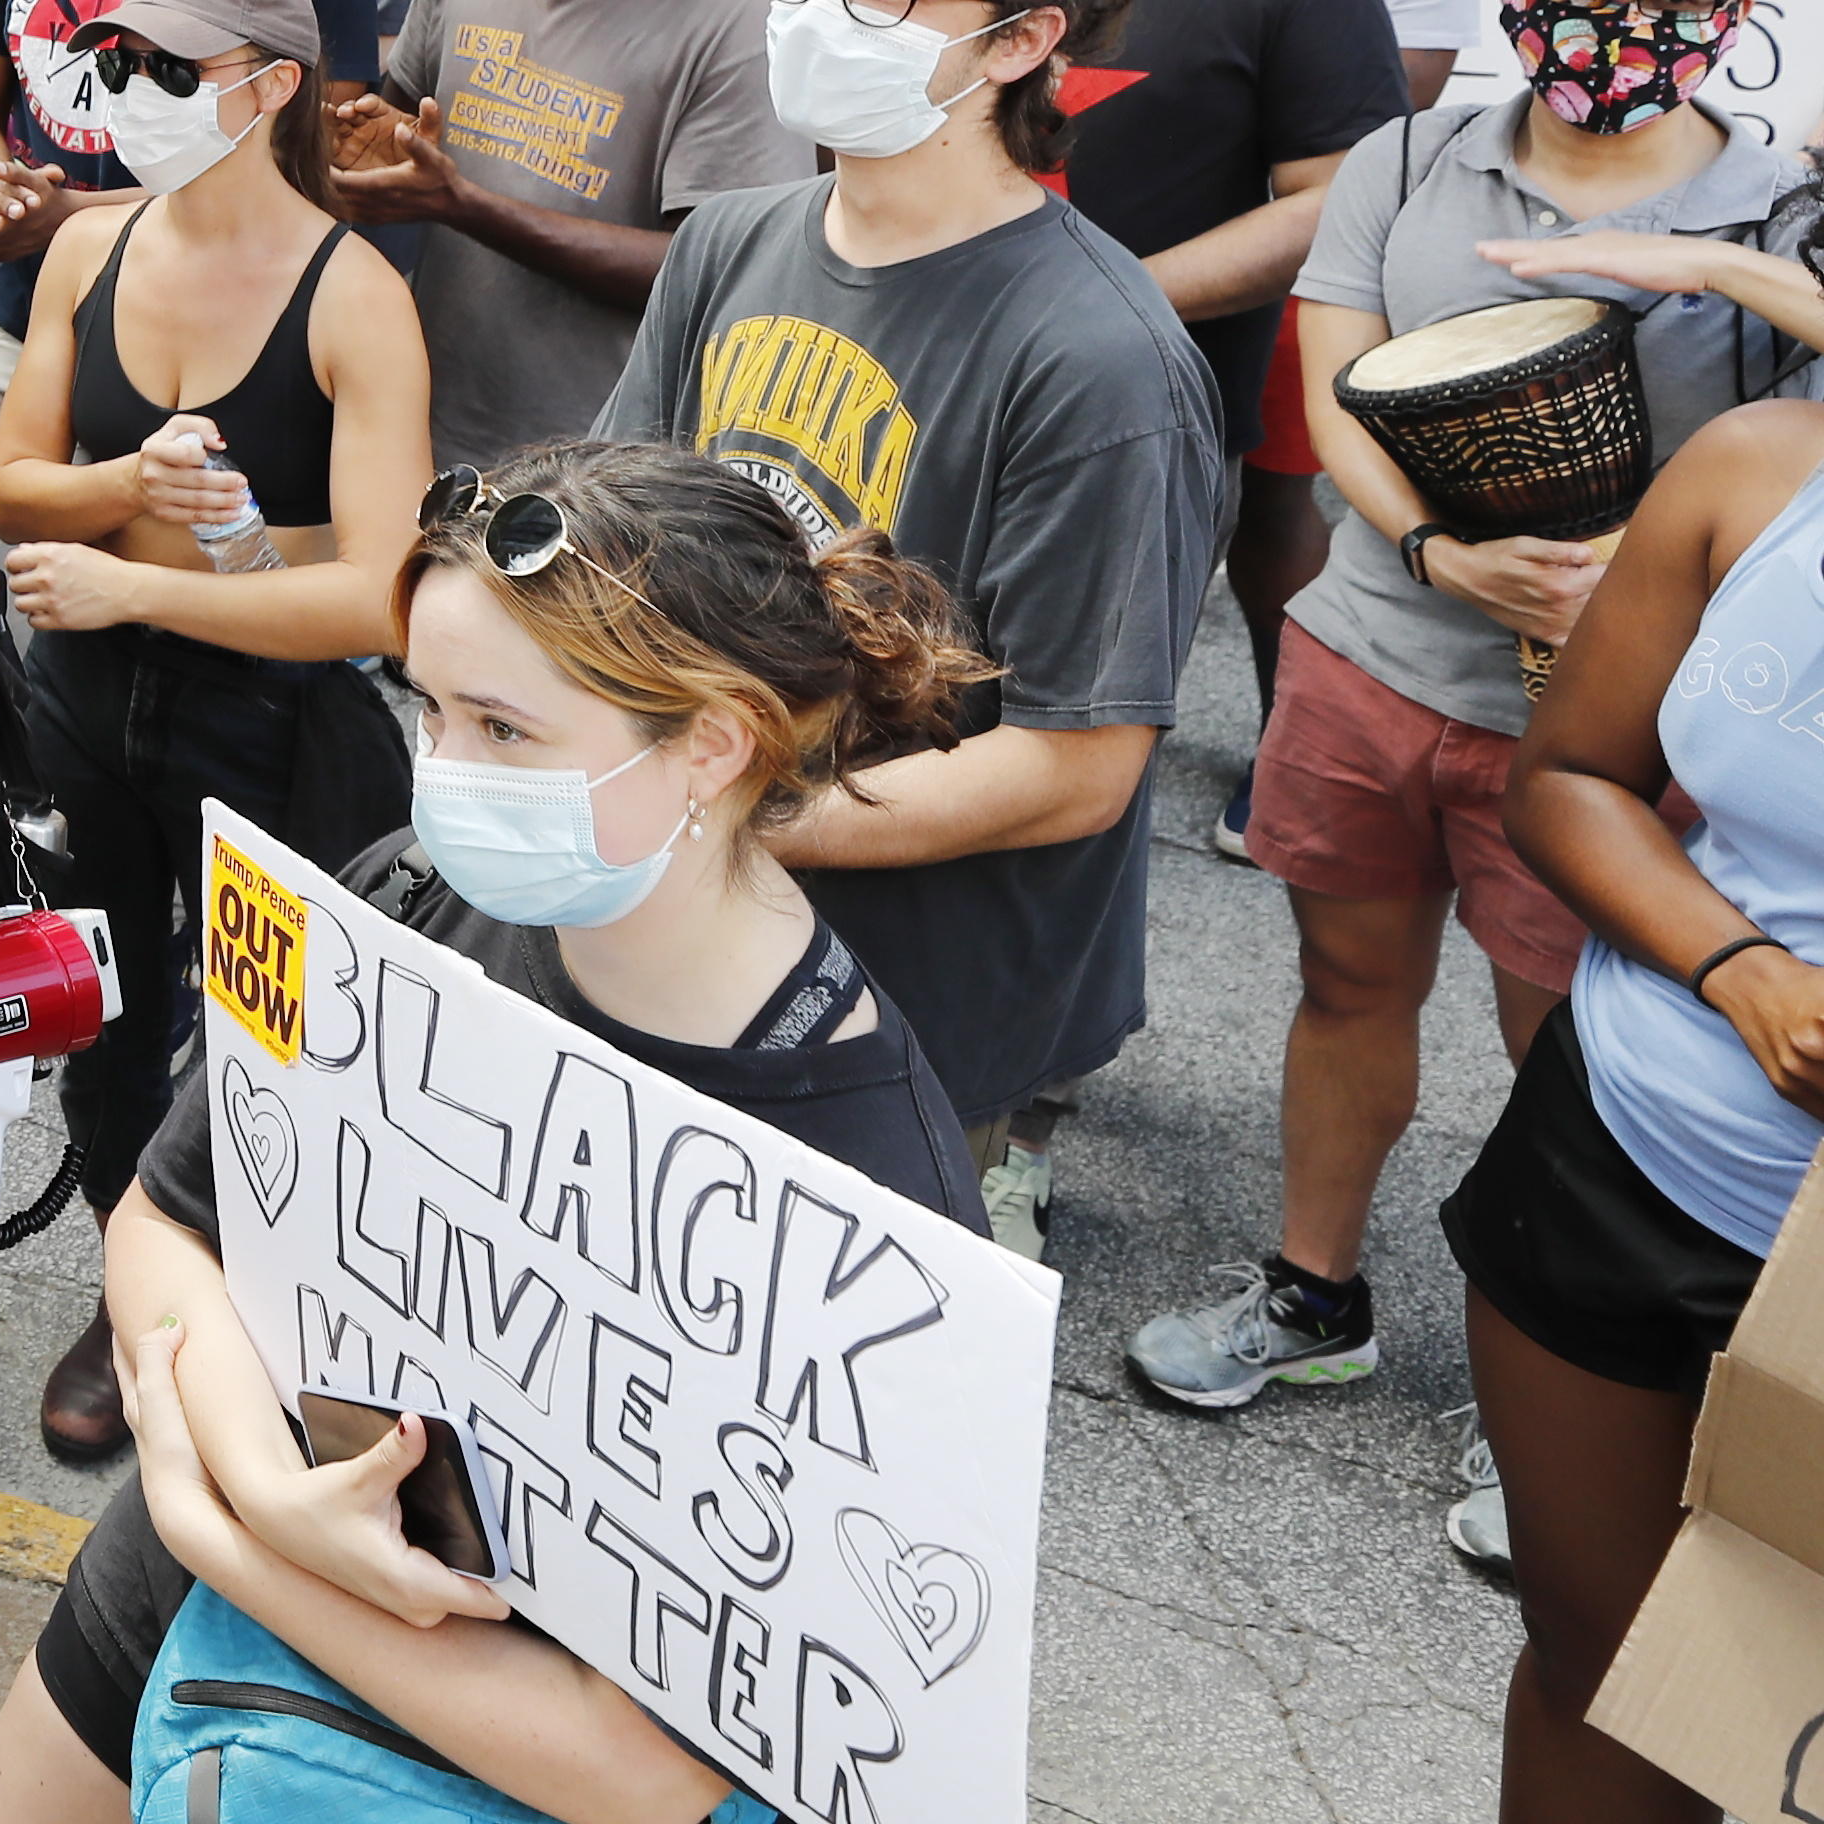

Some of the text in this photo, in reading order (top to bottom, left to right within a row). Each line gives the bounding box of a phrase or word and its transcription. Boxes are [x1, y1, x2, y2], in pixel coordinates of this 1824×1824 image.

[458, 25, 513, 56] It's a
[72, 71, 93, 112] A
[455, 100, 581, 145] GOVERNMENT
[478, 58, 615, 128] STUDENT
[447, 129, 517, 162] 2015-2016
[527, 147, 604, 194] thing!
[213, 833, 305, 931] Trump/Pence
[219, 883, 294, 984] OUT
[210, 926, 298, 1046] NOW
[299, 894, 946, 1473] BLACK
[336, 1116, 793, 1590] LIVES
[296, 1283, 901, 1824] MTTER
